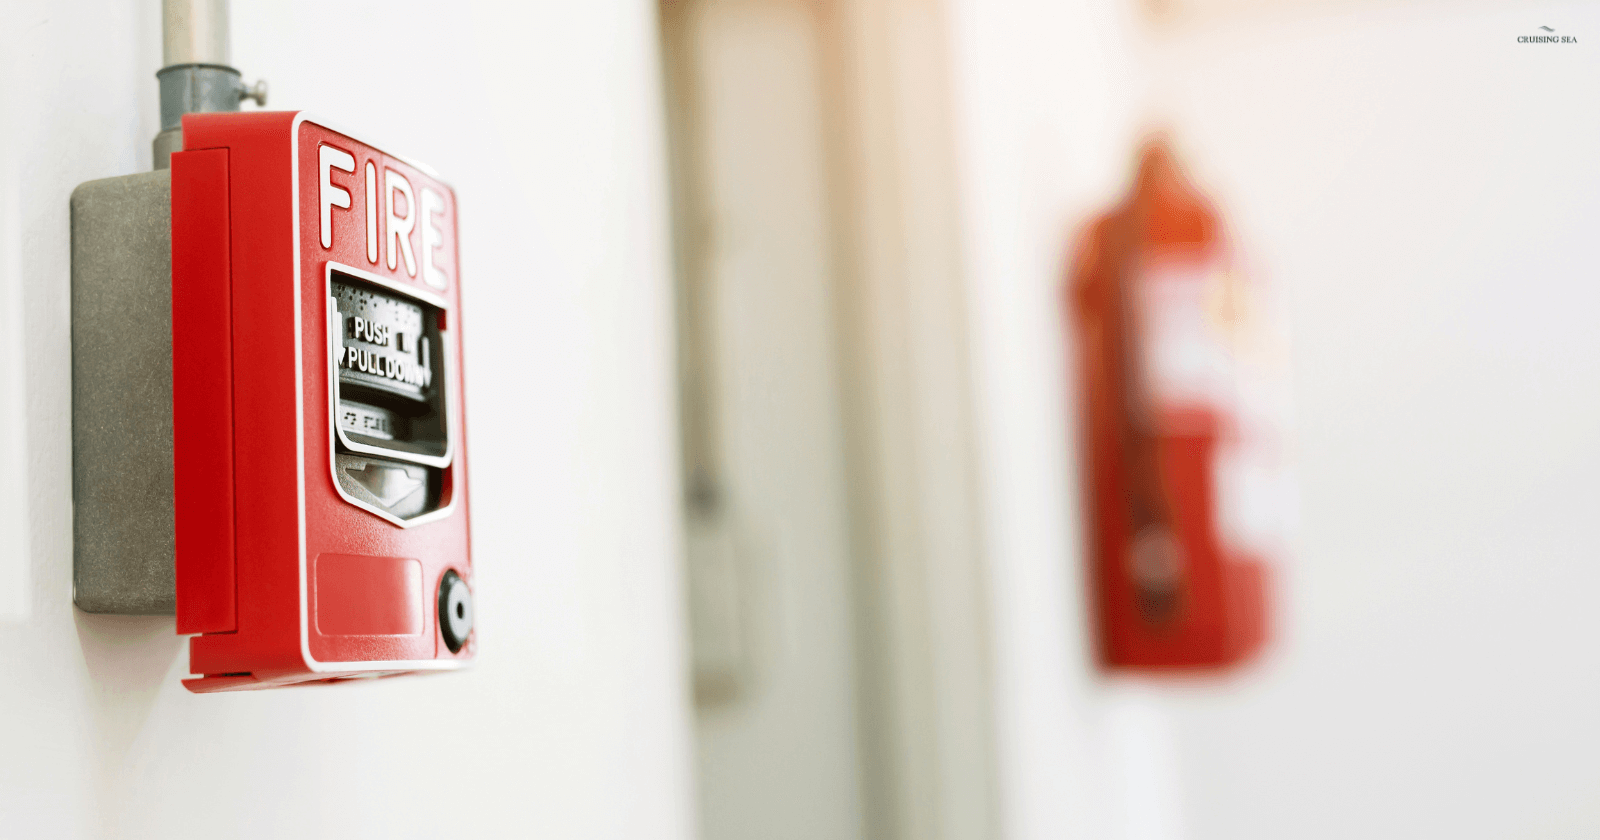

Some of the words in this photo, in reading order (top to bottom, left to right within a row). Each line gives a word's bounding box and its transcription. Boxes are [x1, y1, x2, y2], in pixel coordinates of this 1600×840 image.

[318, 143, 447, 291] FIRE
[354, 316, 390, 347] PUSH
[348, 346, 384, 376] PULL
